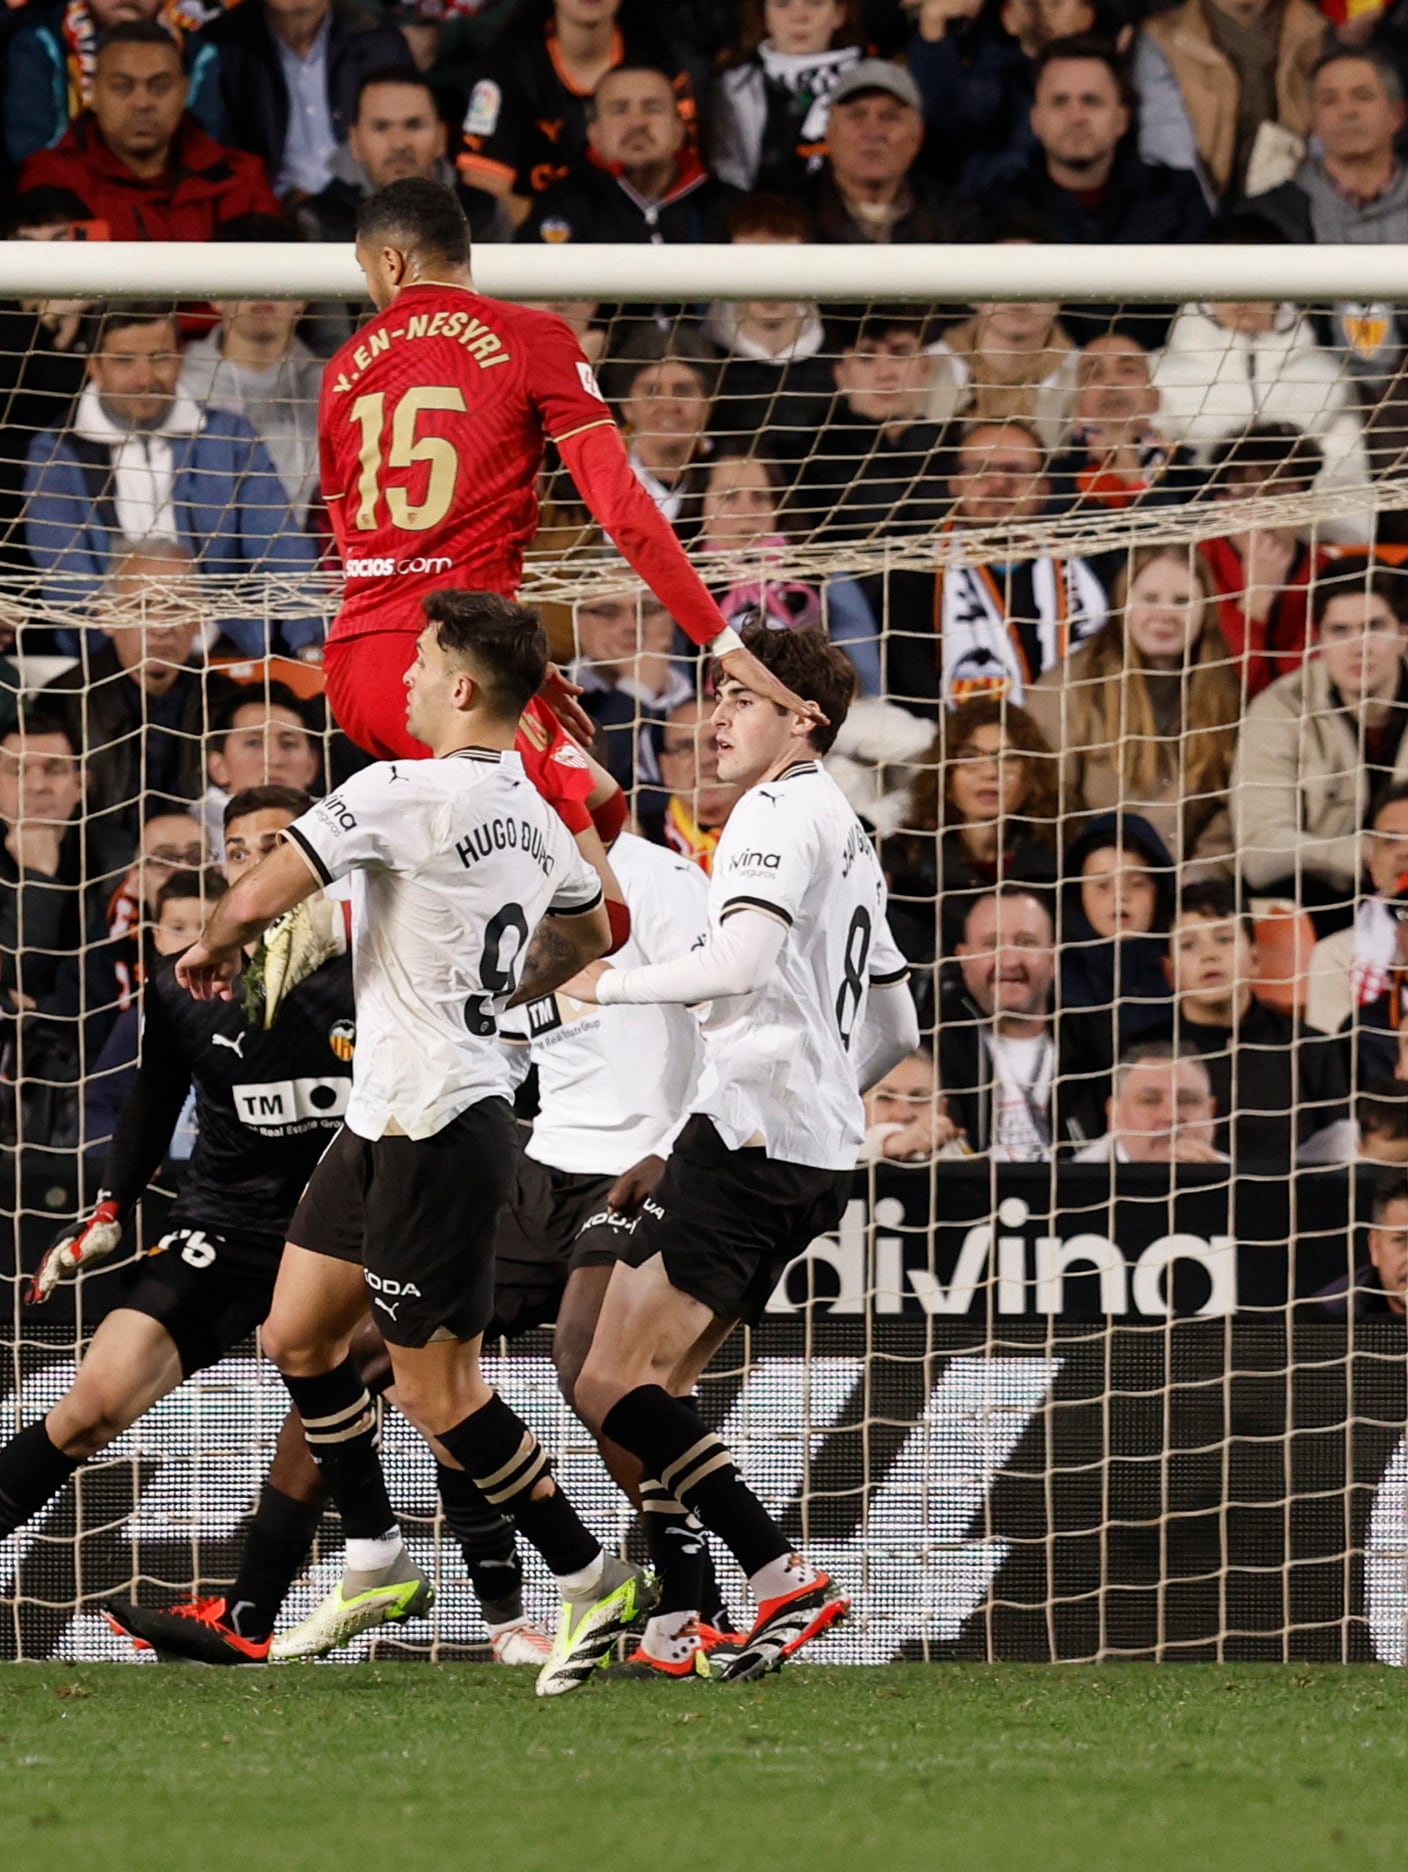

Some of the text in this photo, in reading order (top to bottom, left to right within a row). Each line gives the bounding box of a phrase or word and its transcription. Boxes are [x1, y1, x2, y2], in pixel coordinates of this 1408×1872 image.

[348, 385, 468, 531] 15
[455, 817, 517, 869] HUGO
[463, 902, 529, 1037] 9
[835, 904, 872, 1053] 8
[528, 997, 555, 1029] TM
[242, 1094, 284, 1117] TM
[259, 1127, 285, 1138] Real
[765, 1199, 1237, 1314] divina
